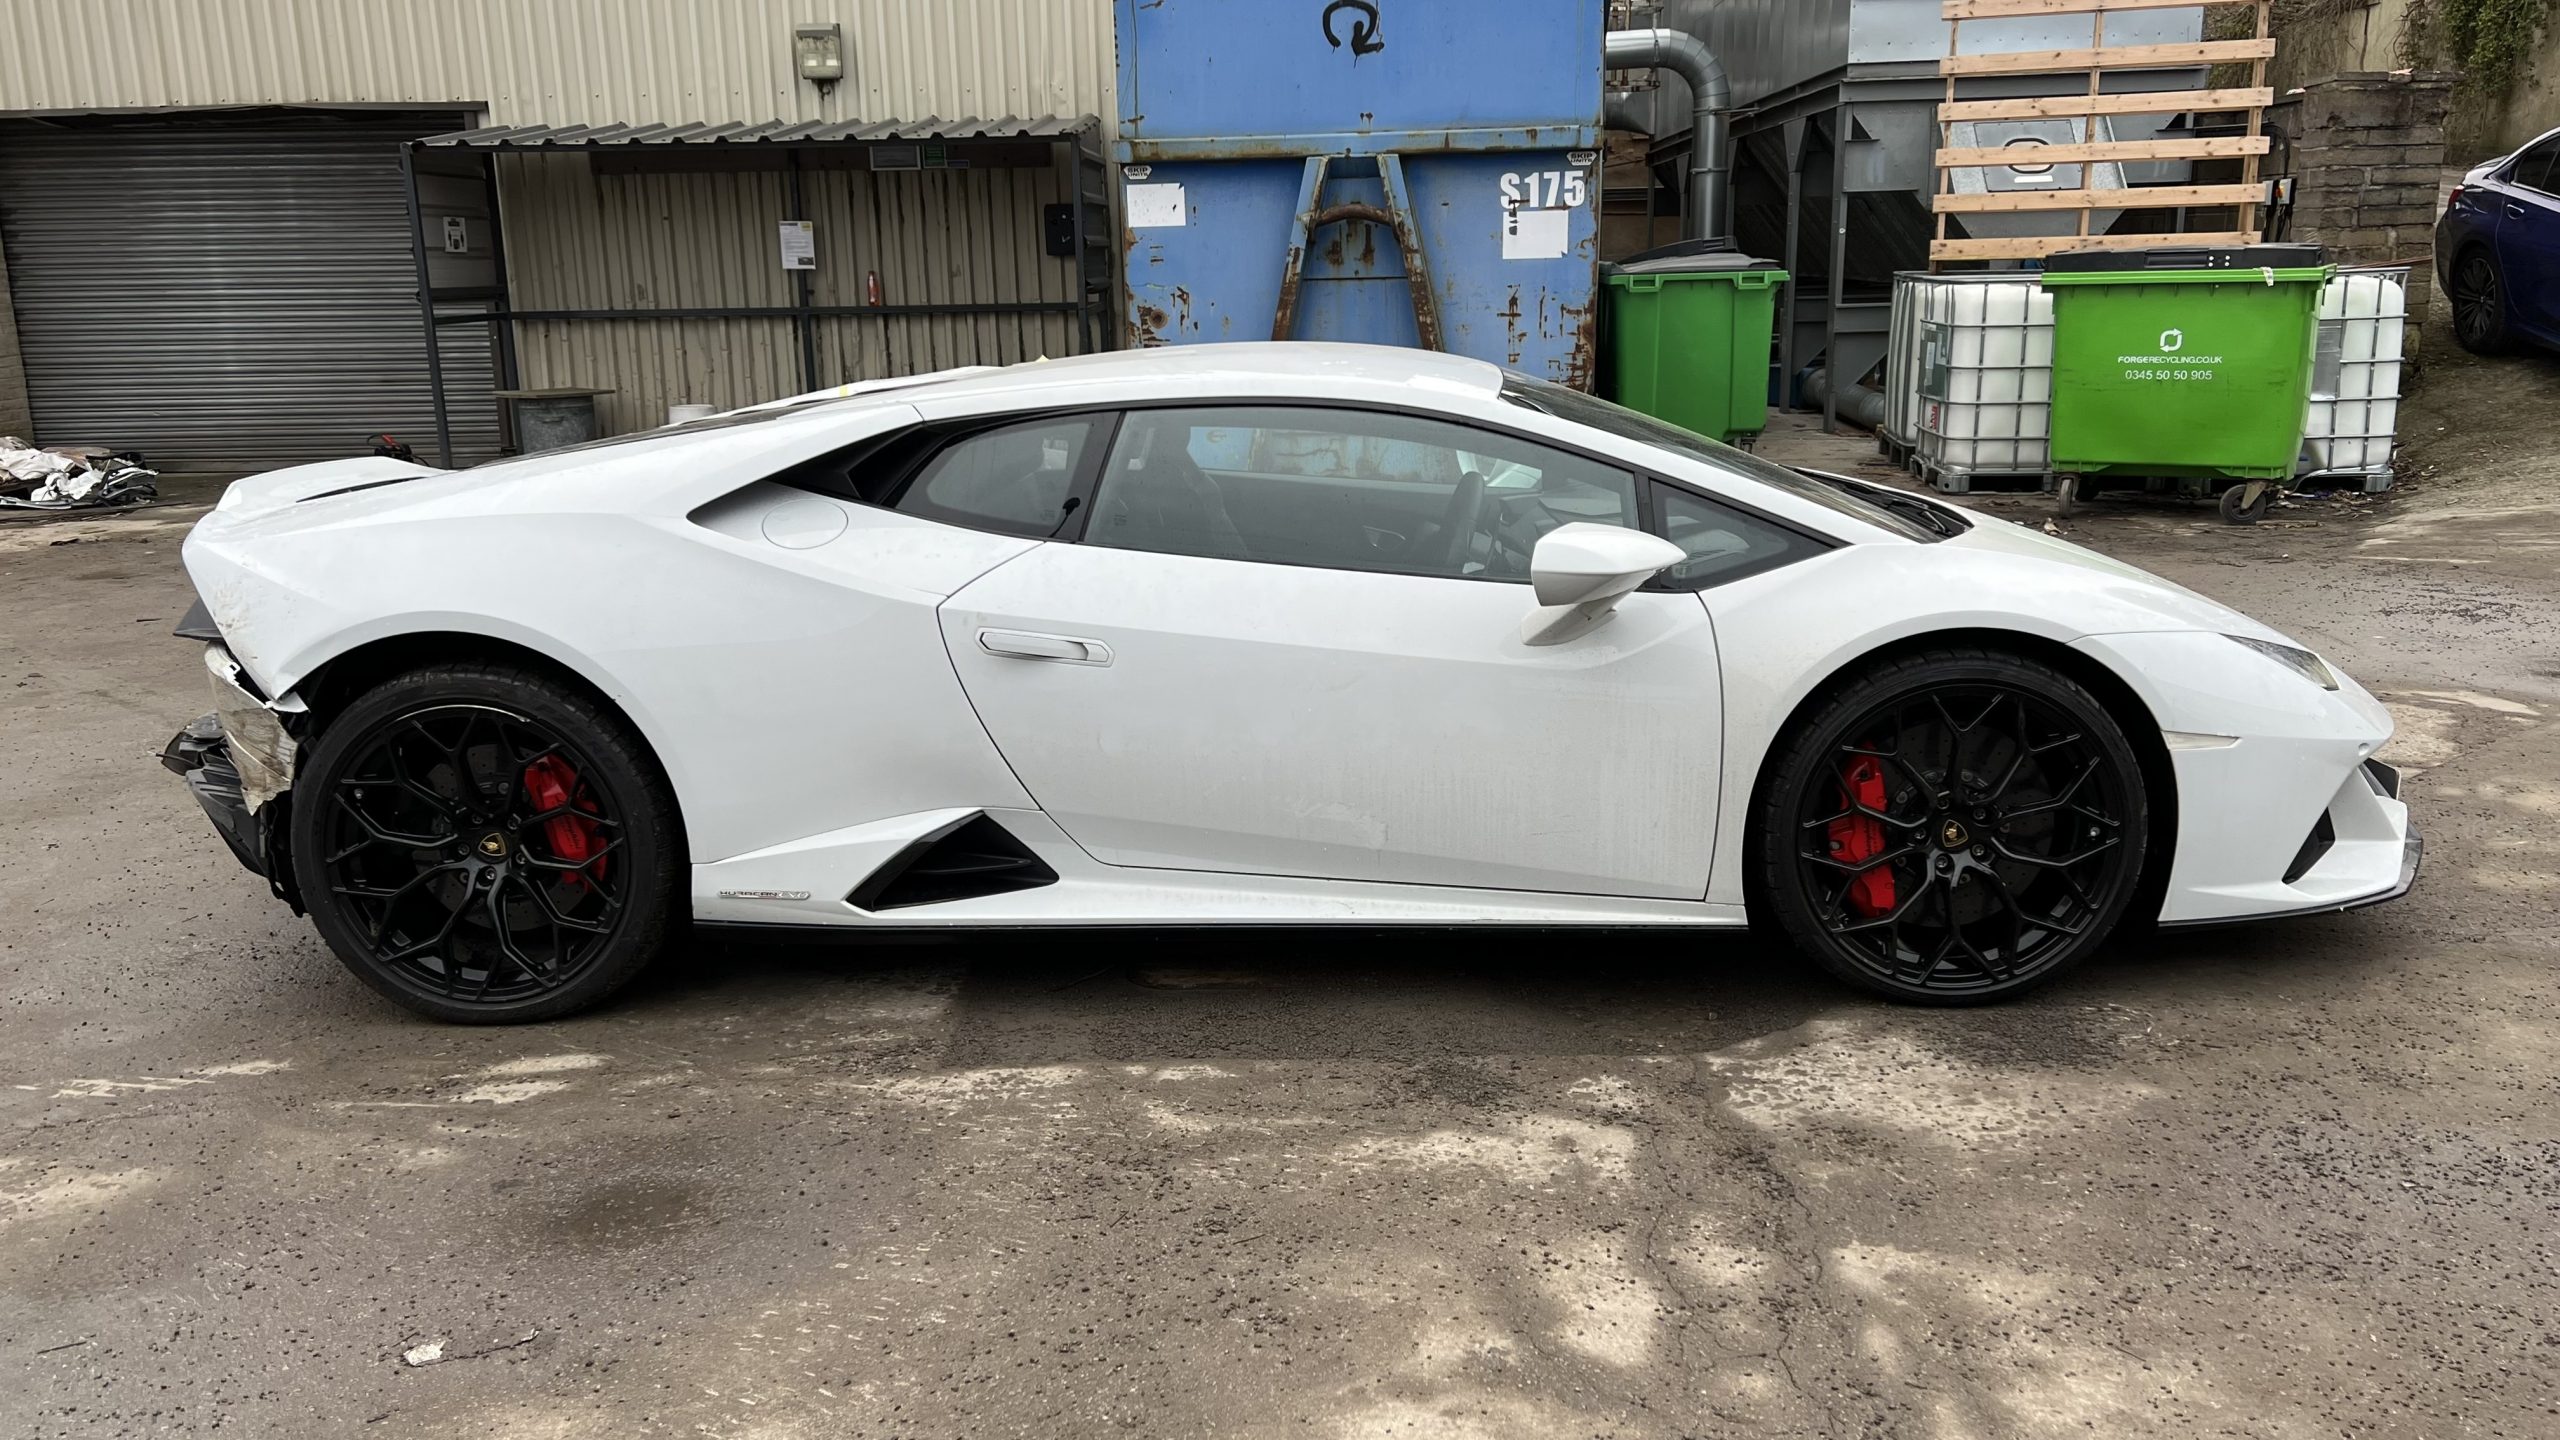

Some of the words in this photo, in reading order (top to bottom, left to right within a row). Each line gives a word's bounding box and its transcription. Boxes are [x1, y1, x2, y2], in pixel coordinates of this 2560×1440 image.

[1500, 170, 1585, 209] S175
[2117, 355, 2223, 364] FORGERECYCLING.CO.UK
[2124, 369, 2153, 380] 0345
[2155, 369, 2171, 380] 50
[2173, 369, 2188, 380] 50
[2190, 369, 2213, 380] 905
